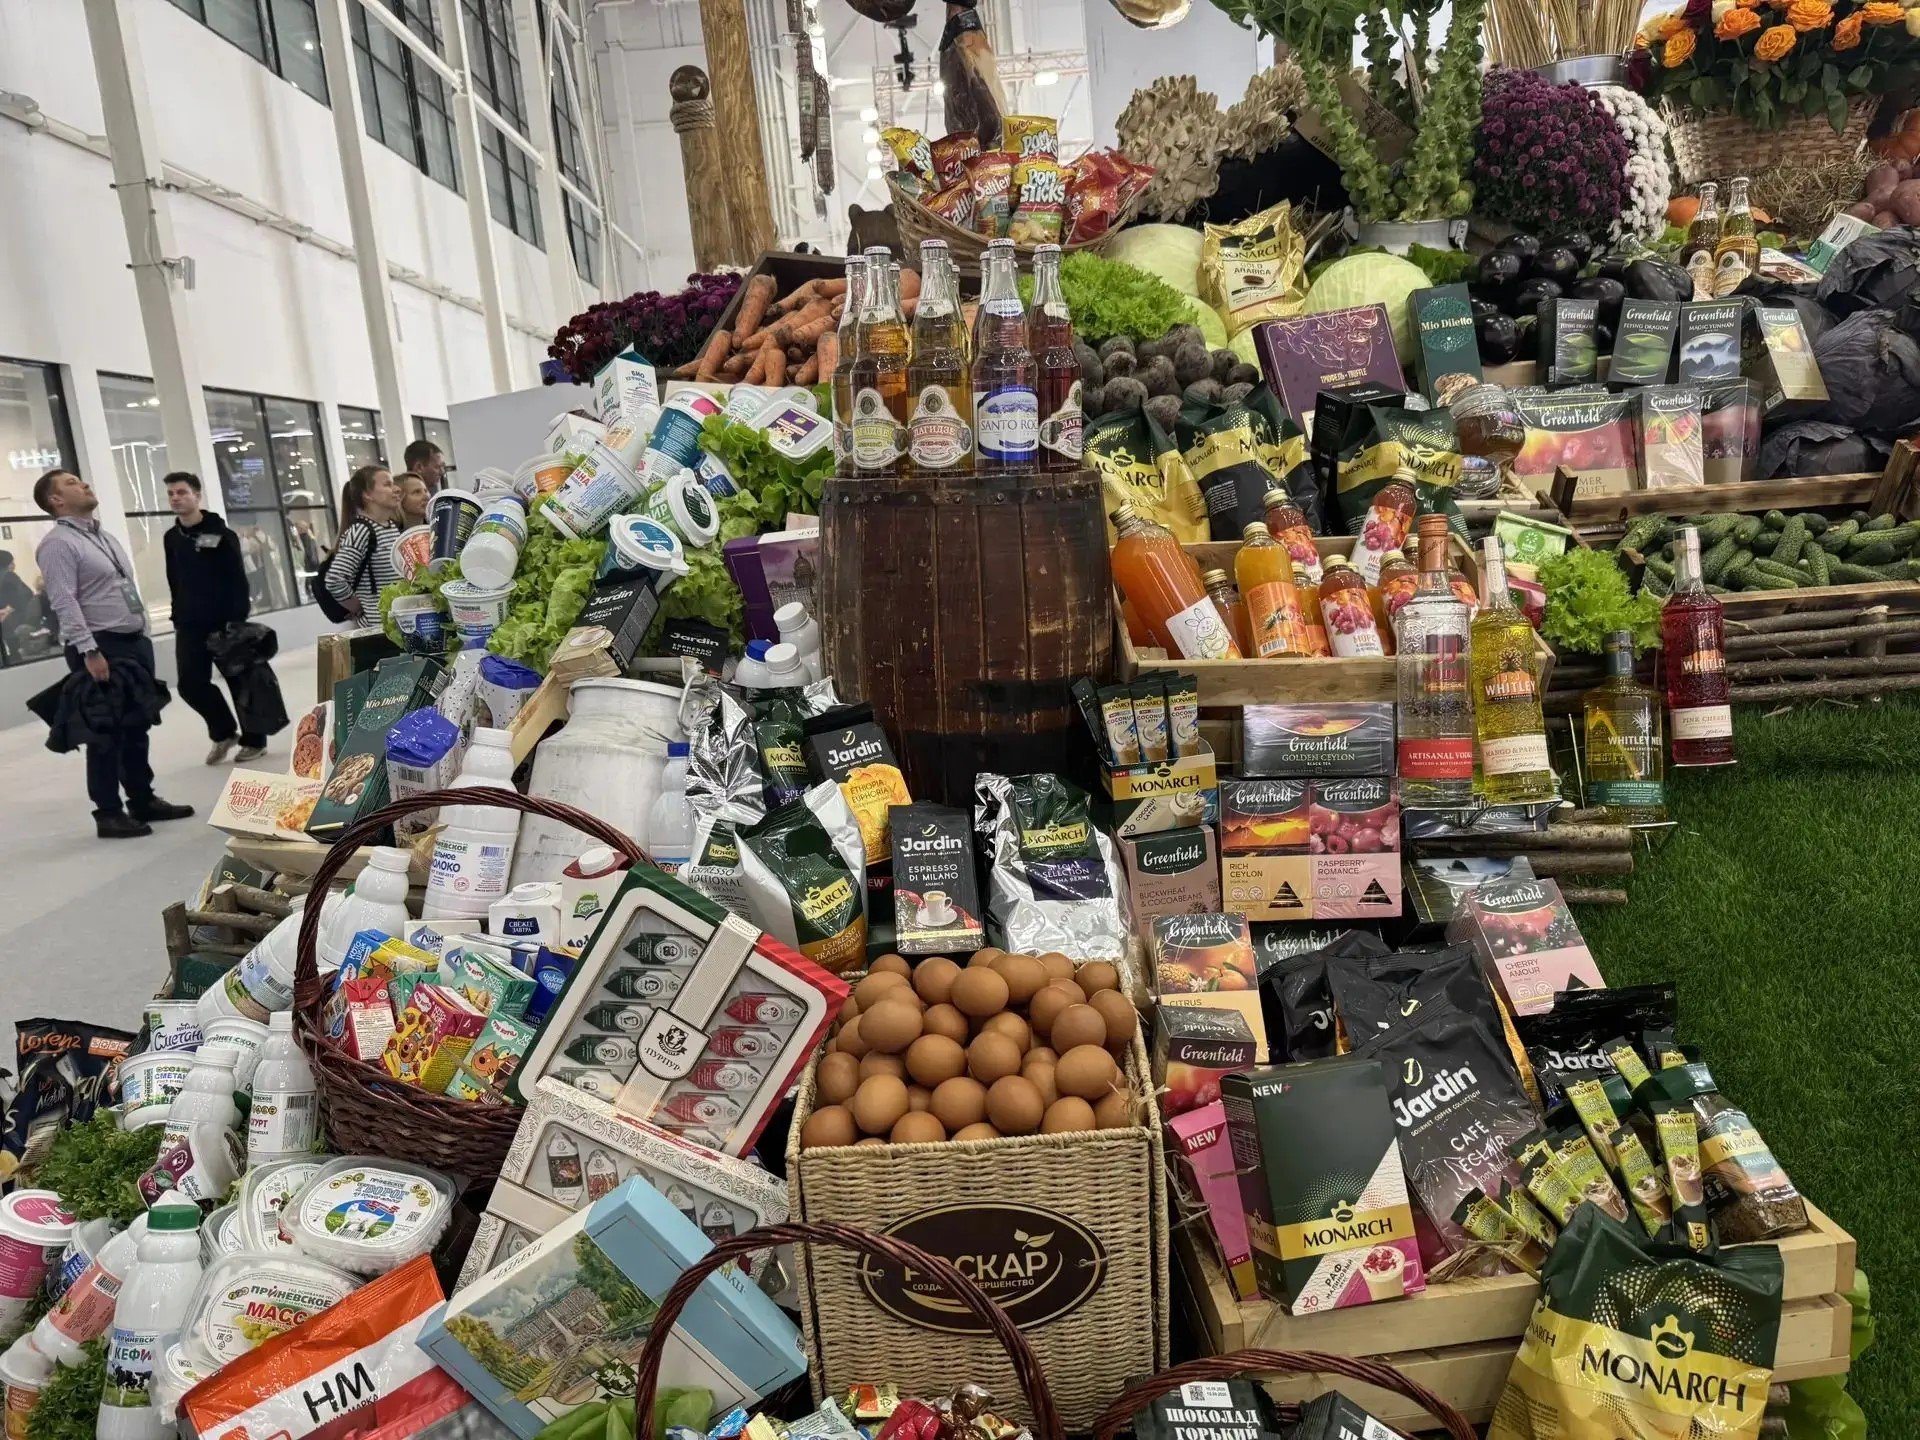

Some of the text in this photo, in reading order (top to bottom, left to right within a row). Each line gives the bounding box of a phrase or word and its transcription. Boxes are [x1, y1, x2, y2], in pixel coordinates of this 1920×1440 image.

[1216, 241, 1283, 259] MONARCH
[1561, 308, 1594, 320] Greenfield
[1626, 308, 1672, 322] Greenfield
[1688, 308, 1737, 322] Greenfield
[1420, 316, 1473, 331] Mio Diletto
[1651, 394, 1695, 408] Greenfield
[980, 418, 1018, 432] SANTO
[1540, 410, 1602, 427] Greenfield
[590, 589, 634, 607] Jardin
[669, 631, 720, 647] Jardin
[1486, 681, 1536, 697] WHITLEY
[1288, 737, 1350, 752] Greenfield
[770, 752, 804, 763] MONA
[828, 740, 882, 766] Jardin
[1282, 753, 1319, 762] GOLDEN
[1408, 752, 1454, 760] ARTISANAL
[1130, 775, 1200, 794] MONARCH
[1236, 787, 1292, 804] Greenfield
[1323, 787, 1383, 801] Greenfield
[1123, 824, 1136, 832] 20
[901, 836, 962, 852] Jardin
[1028, 829, 1083, 844] MONARCH
[1143, 845, 1202, 867] Greenfield
[1317, 859, 1367, 867] RASPBERRY
[432, 859, 461, 873] ОЛОКО
[907, 864, 959, 874] ESPRESSO
[909, 872, 959, 882] DI MILANO
[1230, 870, 1263, 878] CEYLON
[866, 878, 885, 888] EW
[1139, 886, 1187, 899] BUCKWHEAT
[1484, 886, 1545, 906] Greenfield
[1169, 920, 1231, 938] Greenfield
[1505, 958, 1539, 971] CHERRY
[1509, 966, 1541, 978] AMOUR
[1169, 999, 1202, 1007] CITRUS
[20, 1031, 82, 1055] Lorenz
[1181, 1044, 1247, 1063] Greenfield
[1393, 1066, 1478, 1128] Jardin
[1187, 1129, 1217, 1151] NEW
[1303, 1216, 1394, 1249] MONARCH
[1324, 1263, 1342, 1287] РАФ
[976, 1278, 1035, 1291] ЕРШЕНСТВО
[1303, 1295, 1319, 1308] 20
[245, 1301, 308, 1326] МАСС
[1528, 1319, 1557, 1348] NARCH
[113, 1348, 154, 1362] КЕФИ
[1580, 1343, 1747, 1413] MONARCH
[1165, 1407, 1261, 1427] ШОКОЛАД
[1174, 1425, 1259, 1440] ГОРЬКИЙ
